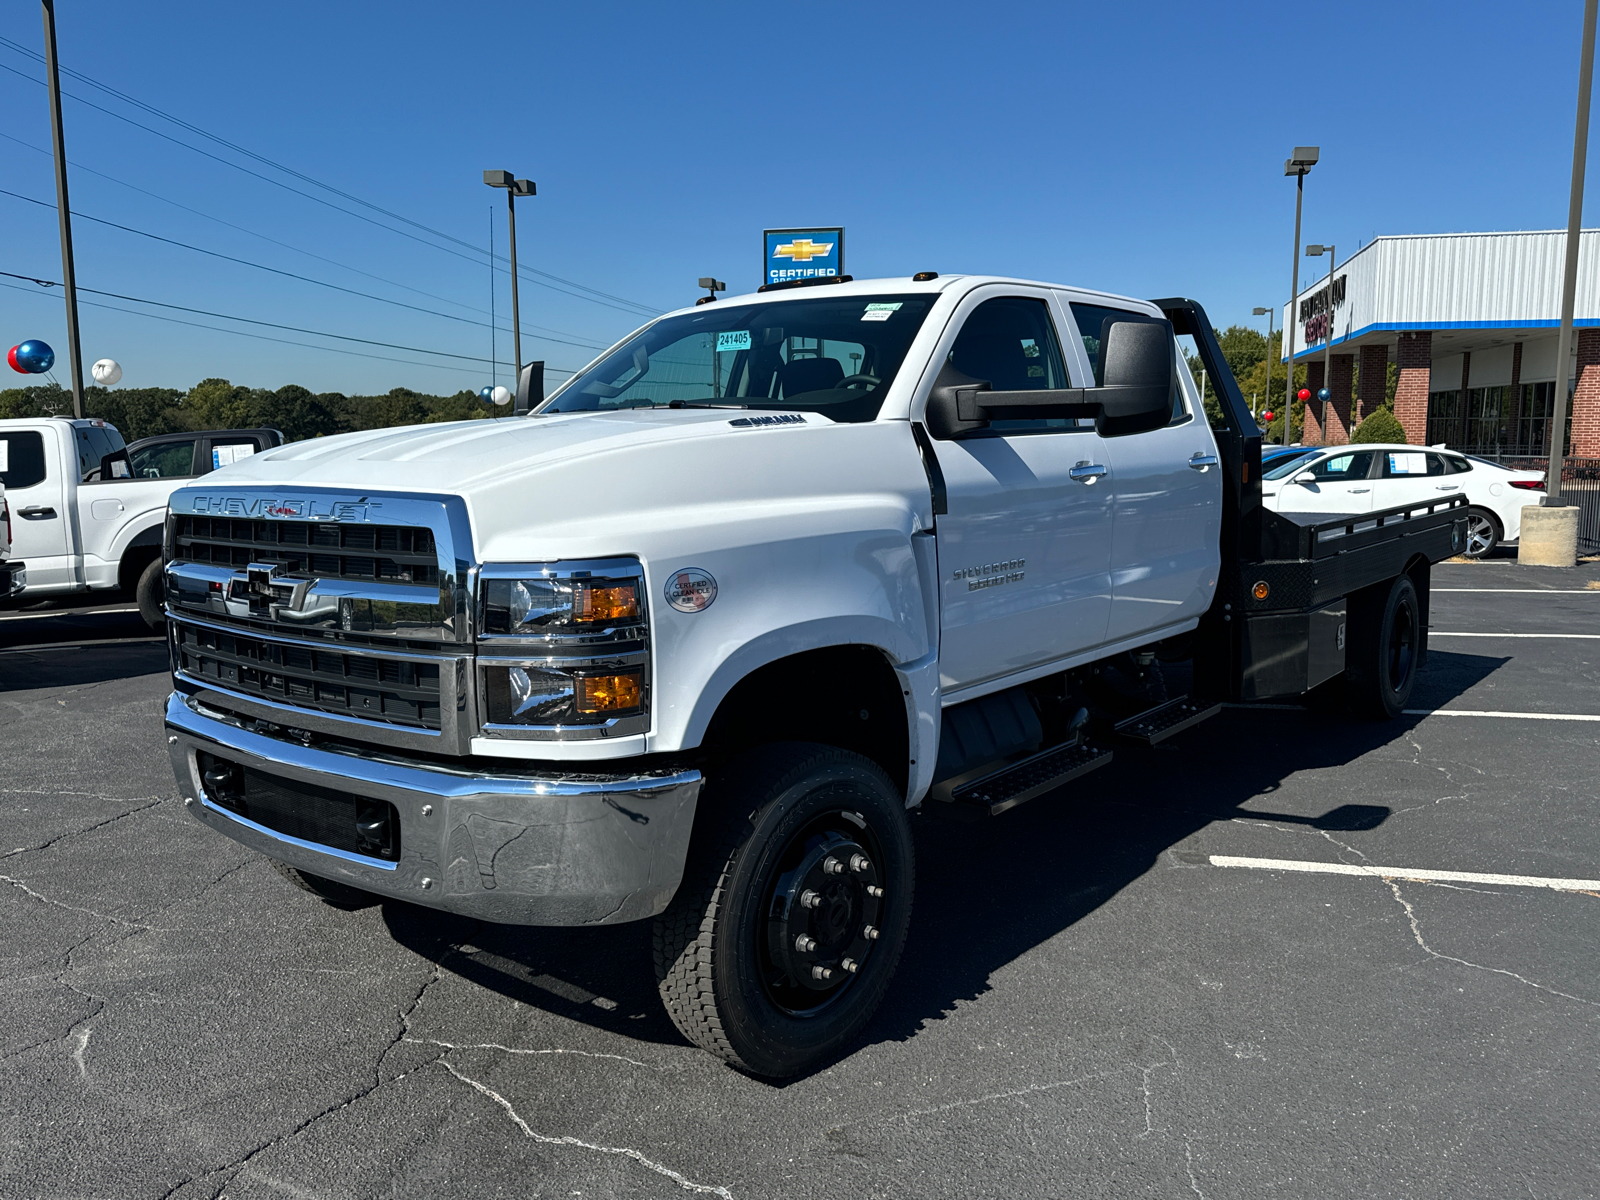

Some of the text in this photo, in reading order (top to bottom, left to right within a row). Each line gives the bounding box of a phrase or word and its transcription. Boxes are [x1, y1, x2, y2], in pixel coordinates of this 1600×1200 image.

[770, 268, 836, 278] CERTIFIED
[720, 333, 748, 345] 241405
[193, 496, 383, 522] CHEVROLET
[953, 558, 1026, 580] SILVERADO
[675, 581, 707, 590] CERTIFIED
[673, 589, 694, 597] CLEAN
